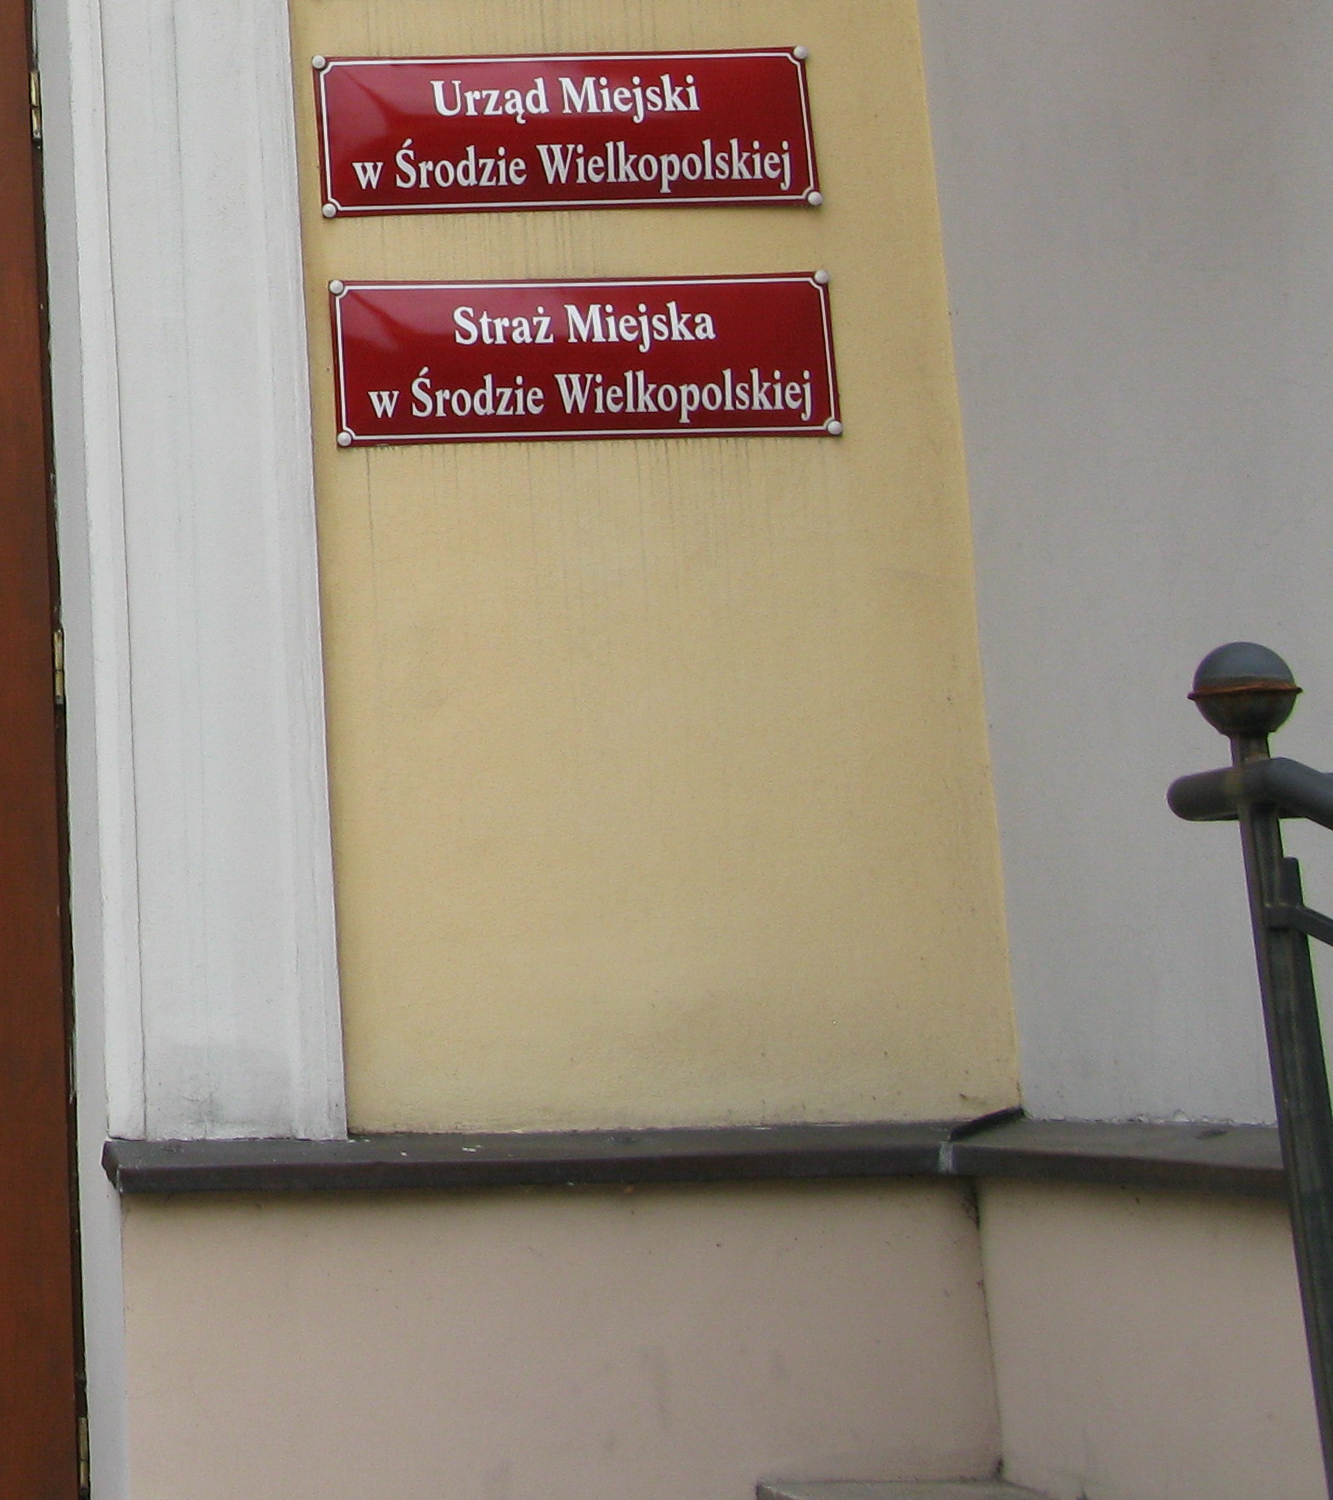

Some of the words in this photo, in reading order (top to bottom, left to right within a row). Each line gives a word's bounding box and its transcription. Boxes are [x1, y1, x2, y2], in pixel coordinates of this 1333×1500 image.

[429, 76, 550, 125] Urząd
[557, 73, 700, 124] Miejski
[352, 161, 384, 190] w
[395, 138, 527, 189] Środzie
[535, 138, 791, 193] Wielkopolskiej
[453, 305, 554, 345] Straż
[563, 300, 716, 353] Miejska
[367, 390, 400, 419] w
[411, 366, 544, 417] Środzie
[554, 367, 812, 423] Wielkopolskiej
